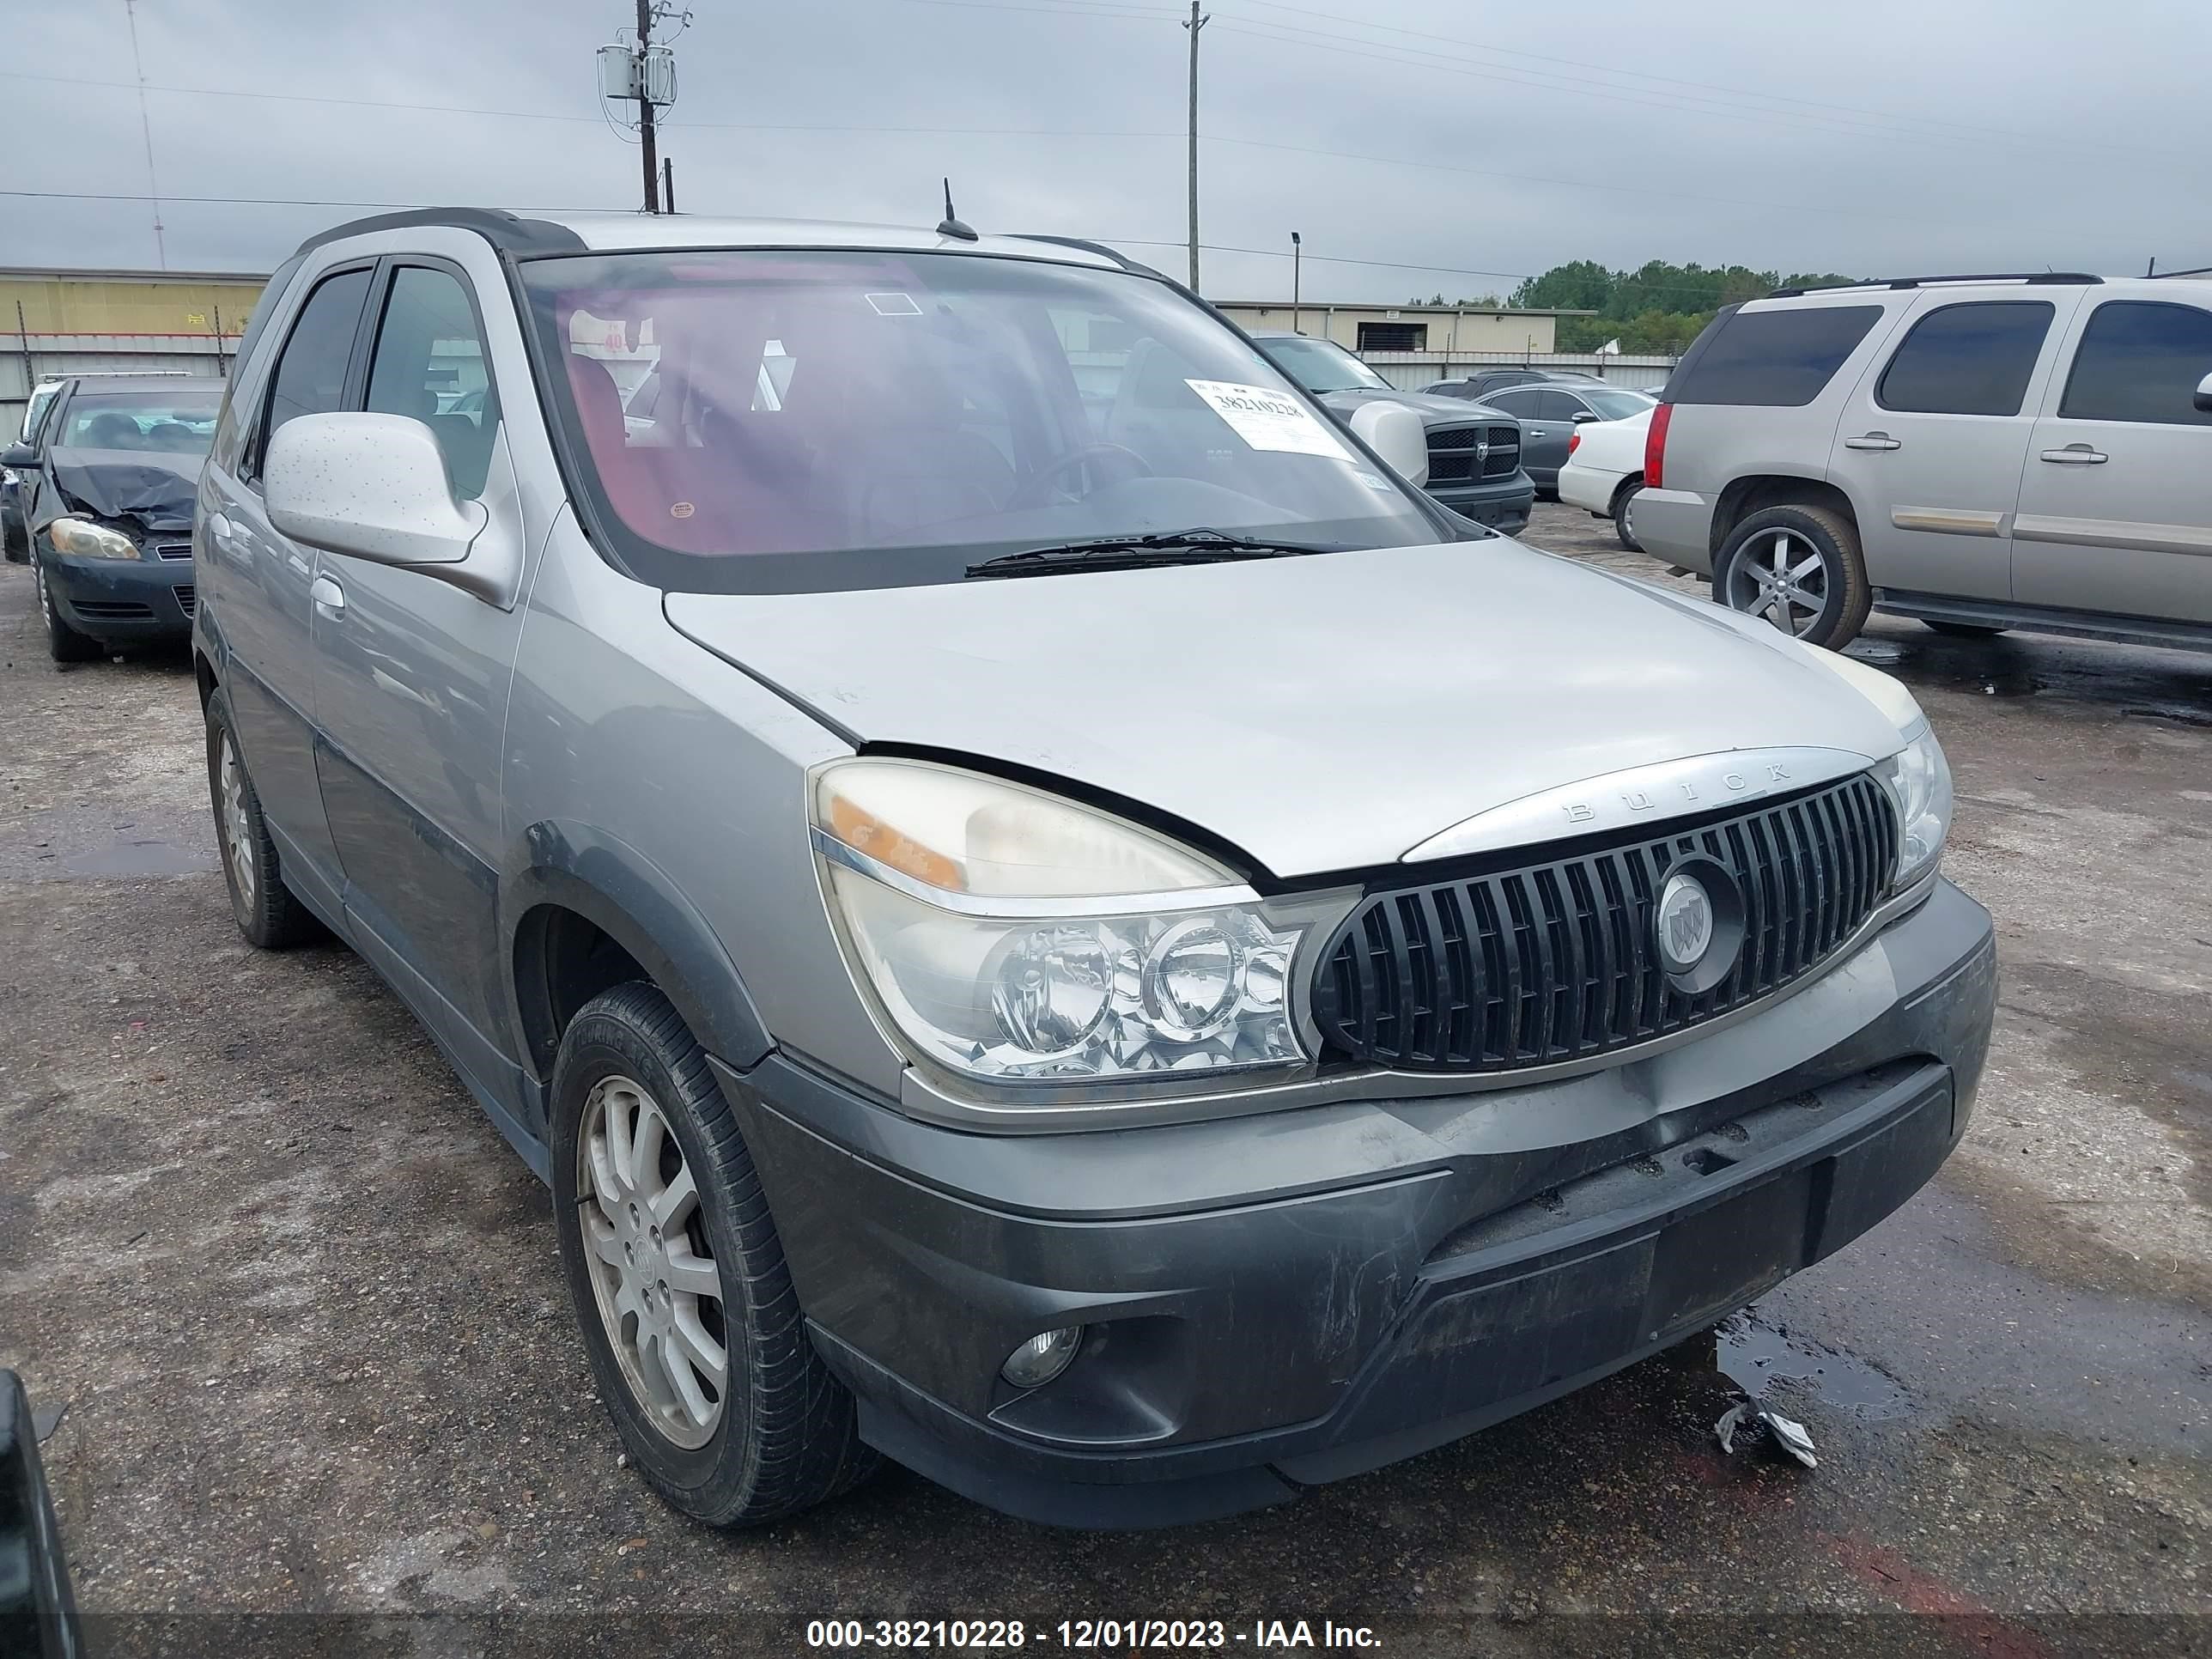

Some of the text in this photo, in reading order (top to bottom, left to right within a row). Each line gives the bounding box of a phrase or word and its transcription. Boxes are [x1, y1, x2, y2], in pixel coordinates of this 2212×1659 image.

[605, 334, 623, 350] 40
[1215, 395, 1304, 418] 38210228
[1563, 763, 1790, 823] BUICK
